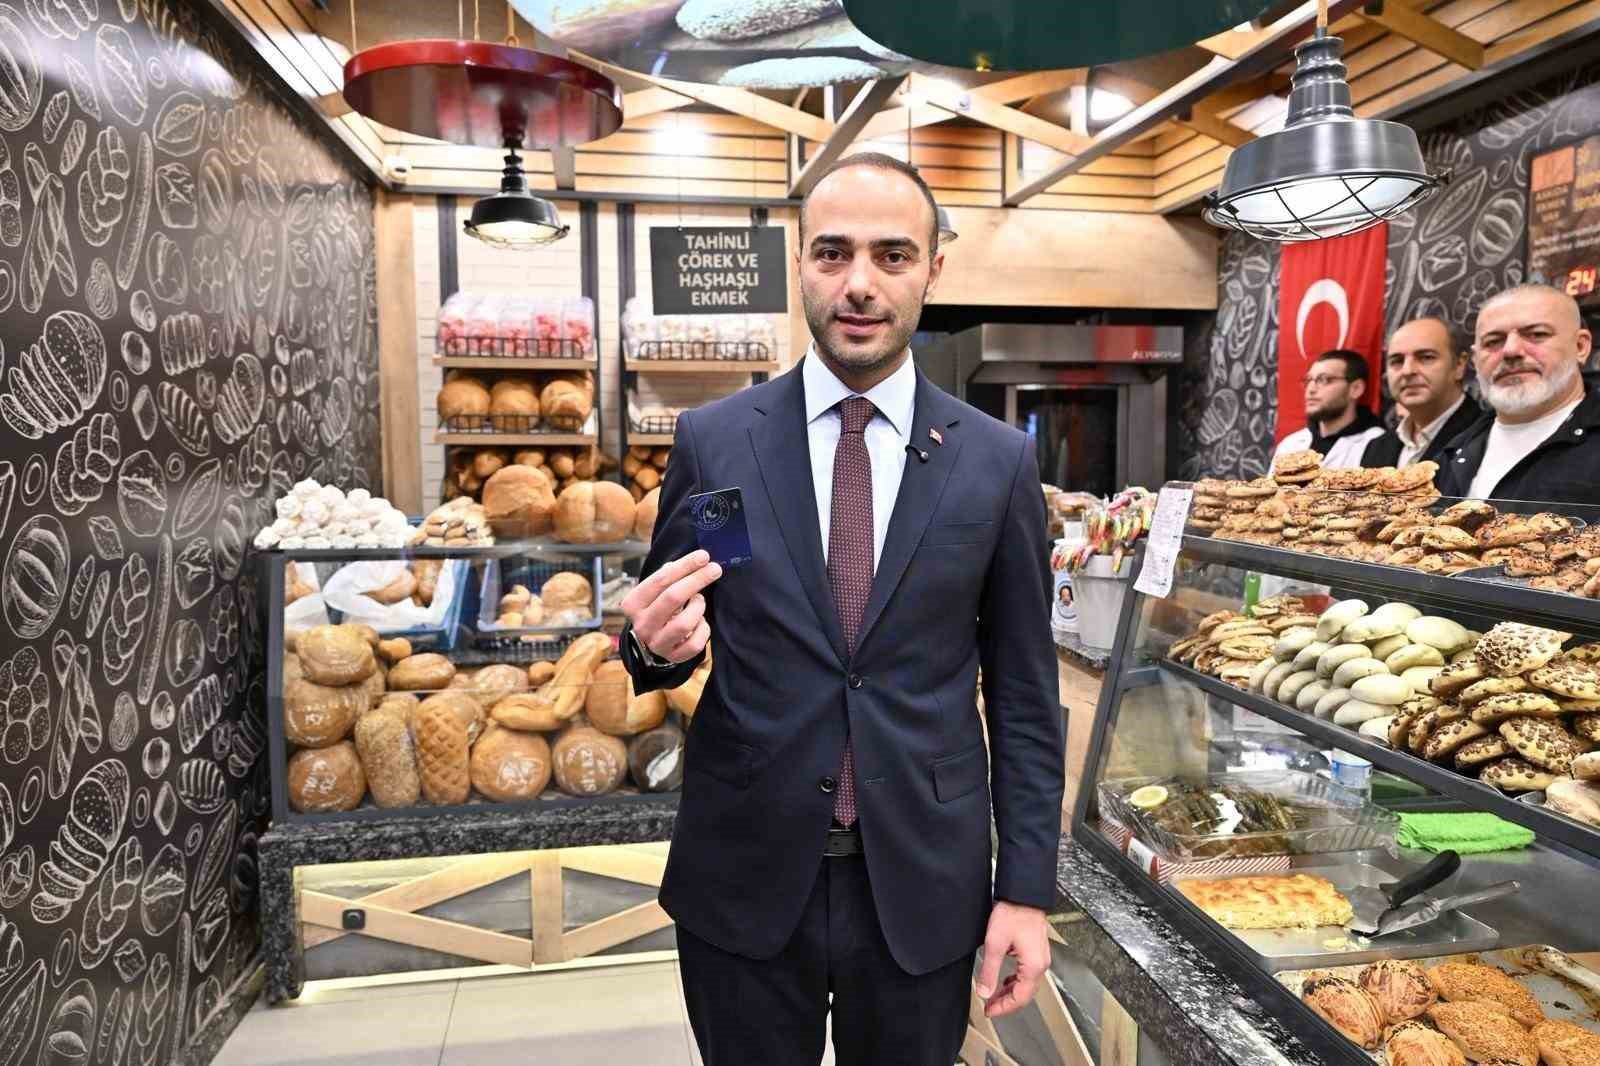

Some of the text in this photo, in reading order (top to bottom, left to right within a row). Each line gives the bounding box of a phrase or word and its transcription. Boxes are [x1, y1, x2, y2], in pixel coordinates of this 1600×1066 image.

[684, 231, 750, 250] TAHİNLİ
[678, 250, 760, 273] ÇÖREK VE
[679, 272, 760, 291] HAŞHAŞLI
[1566, 269, 1597, 296] 24
[691, 291, 749, 306] EKMEK
